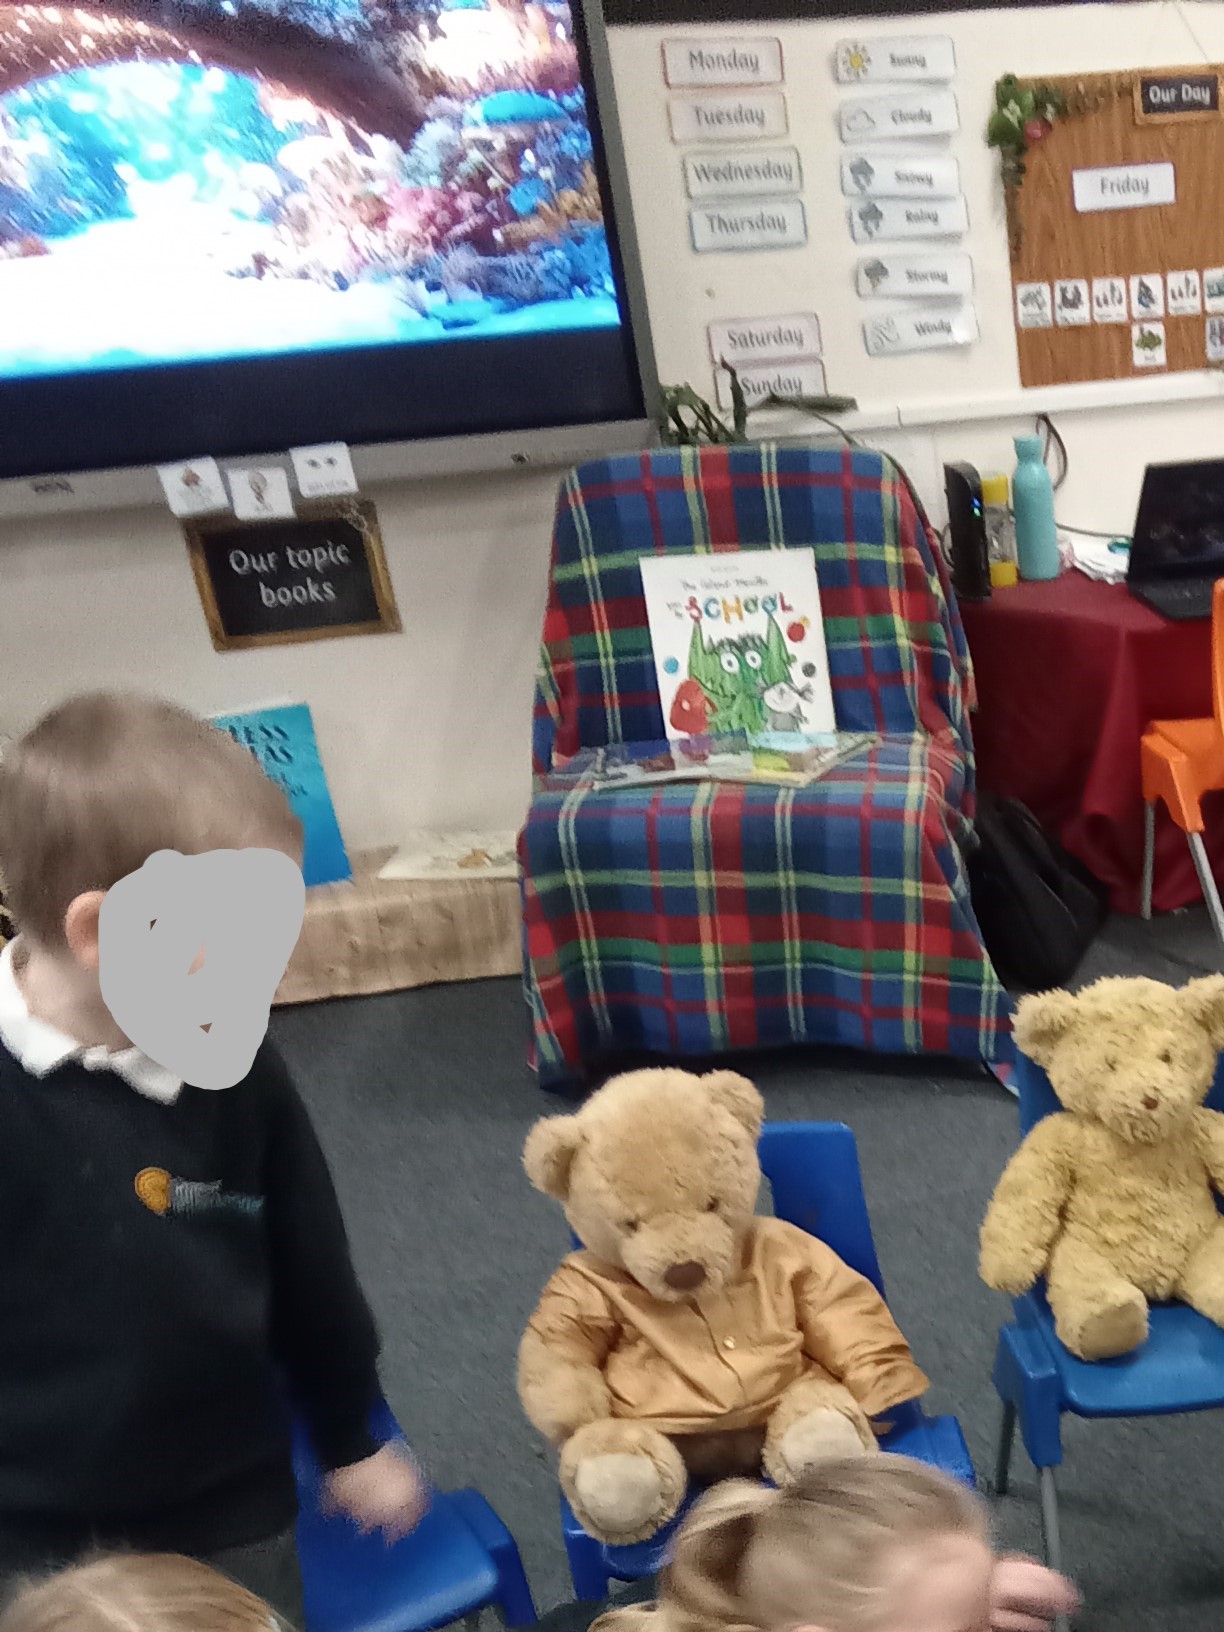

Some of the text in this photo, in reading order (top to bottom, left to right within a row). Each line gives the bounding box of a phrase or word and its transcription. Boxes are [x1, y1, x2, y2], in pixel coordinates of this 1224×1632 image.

[689, 48, 760, 74] Monday
[1149, 83, 1210, 105] Our Day
[693, 103, 765, 127] Tuesday
[693, 159, 793, 183] Wednesday
[1100, 173, 1149, 197] Friday
[705, 211, 787, 235] Thursday
[727, 325, 804, 350] Saturday
[740, 373, 803, 398] Sunday
[229, 540, 351, 575] Our topic
[259, 577, 337, 609] books
[685, 591, 793, 625] SCHOOL
